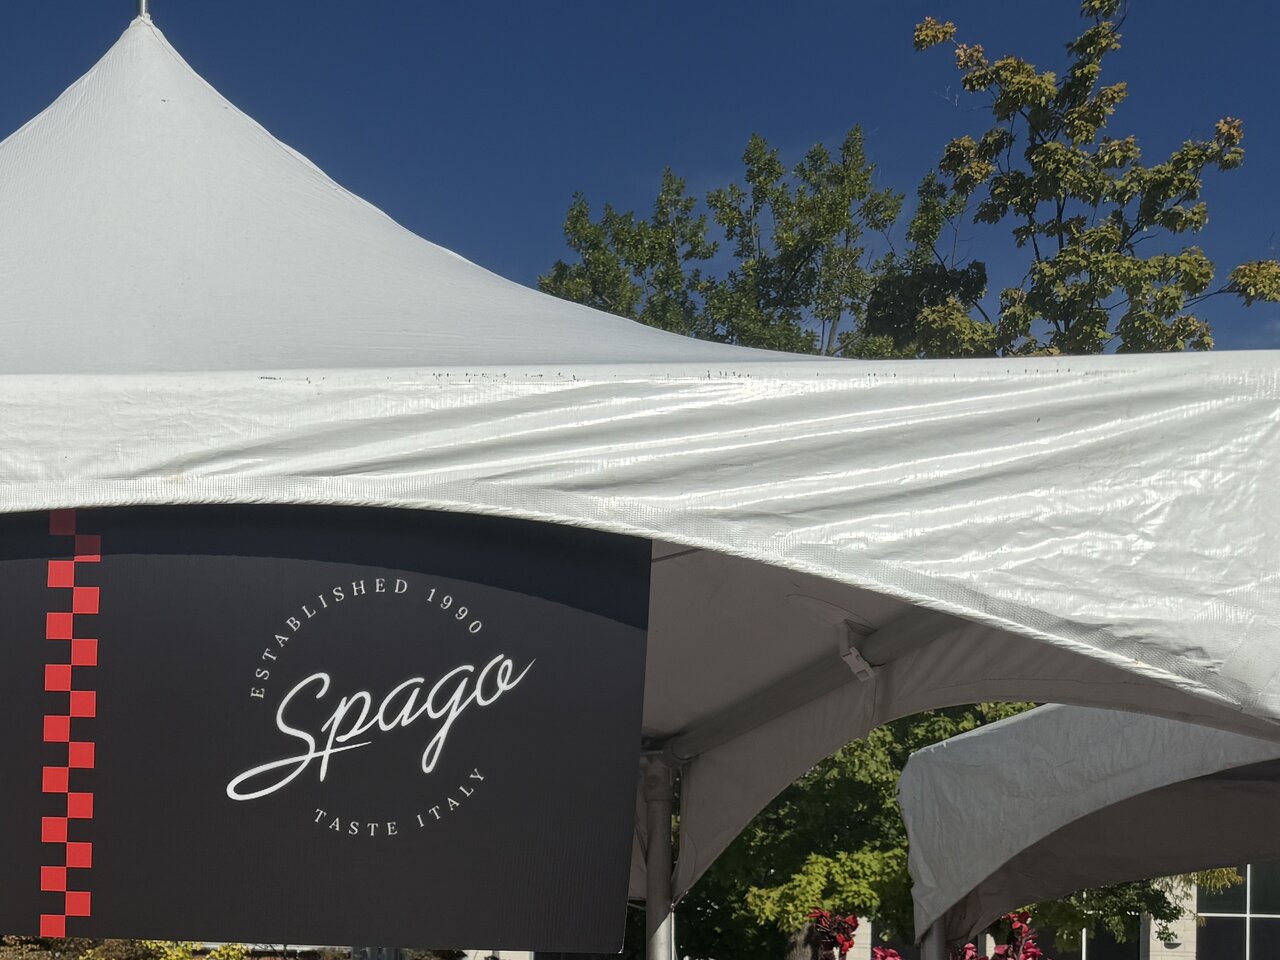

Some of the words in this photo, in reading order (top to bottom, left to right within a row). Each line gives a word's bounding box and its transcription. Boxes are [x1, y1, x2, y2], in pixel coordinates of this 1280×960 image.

[250, 578, 408, 699] ESTABLISHED
[426, 588, 483, 635] 1990
[226, 653, 537, 801] Spago
[314, 808, 398, 837] TASTE
[416, 768, 486, 829] ITALY
